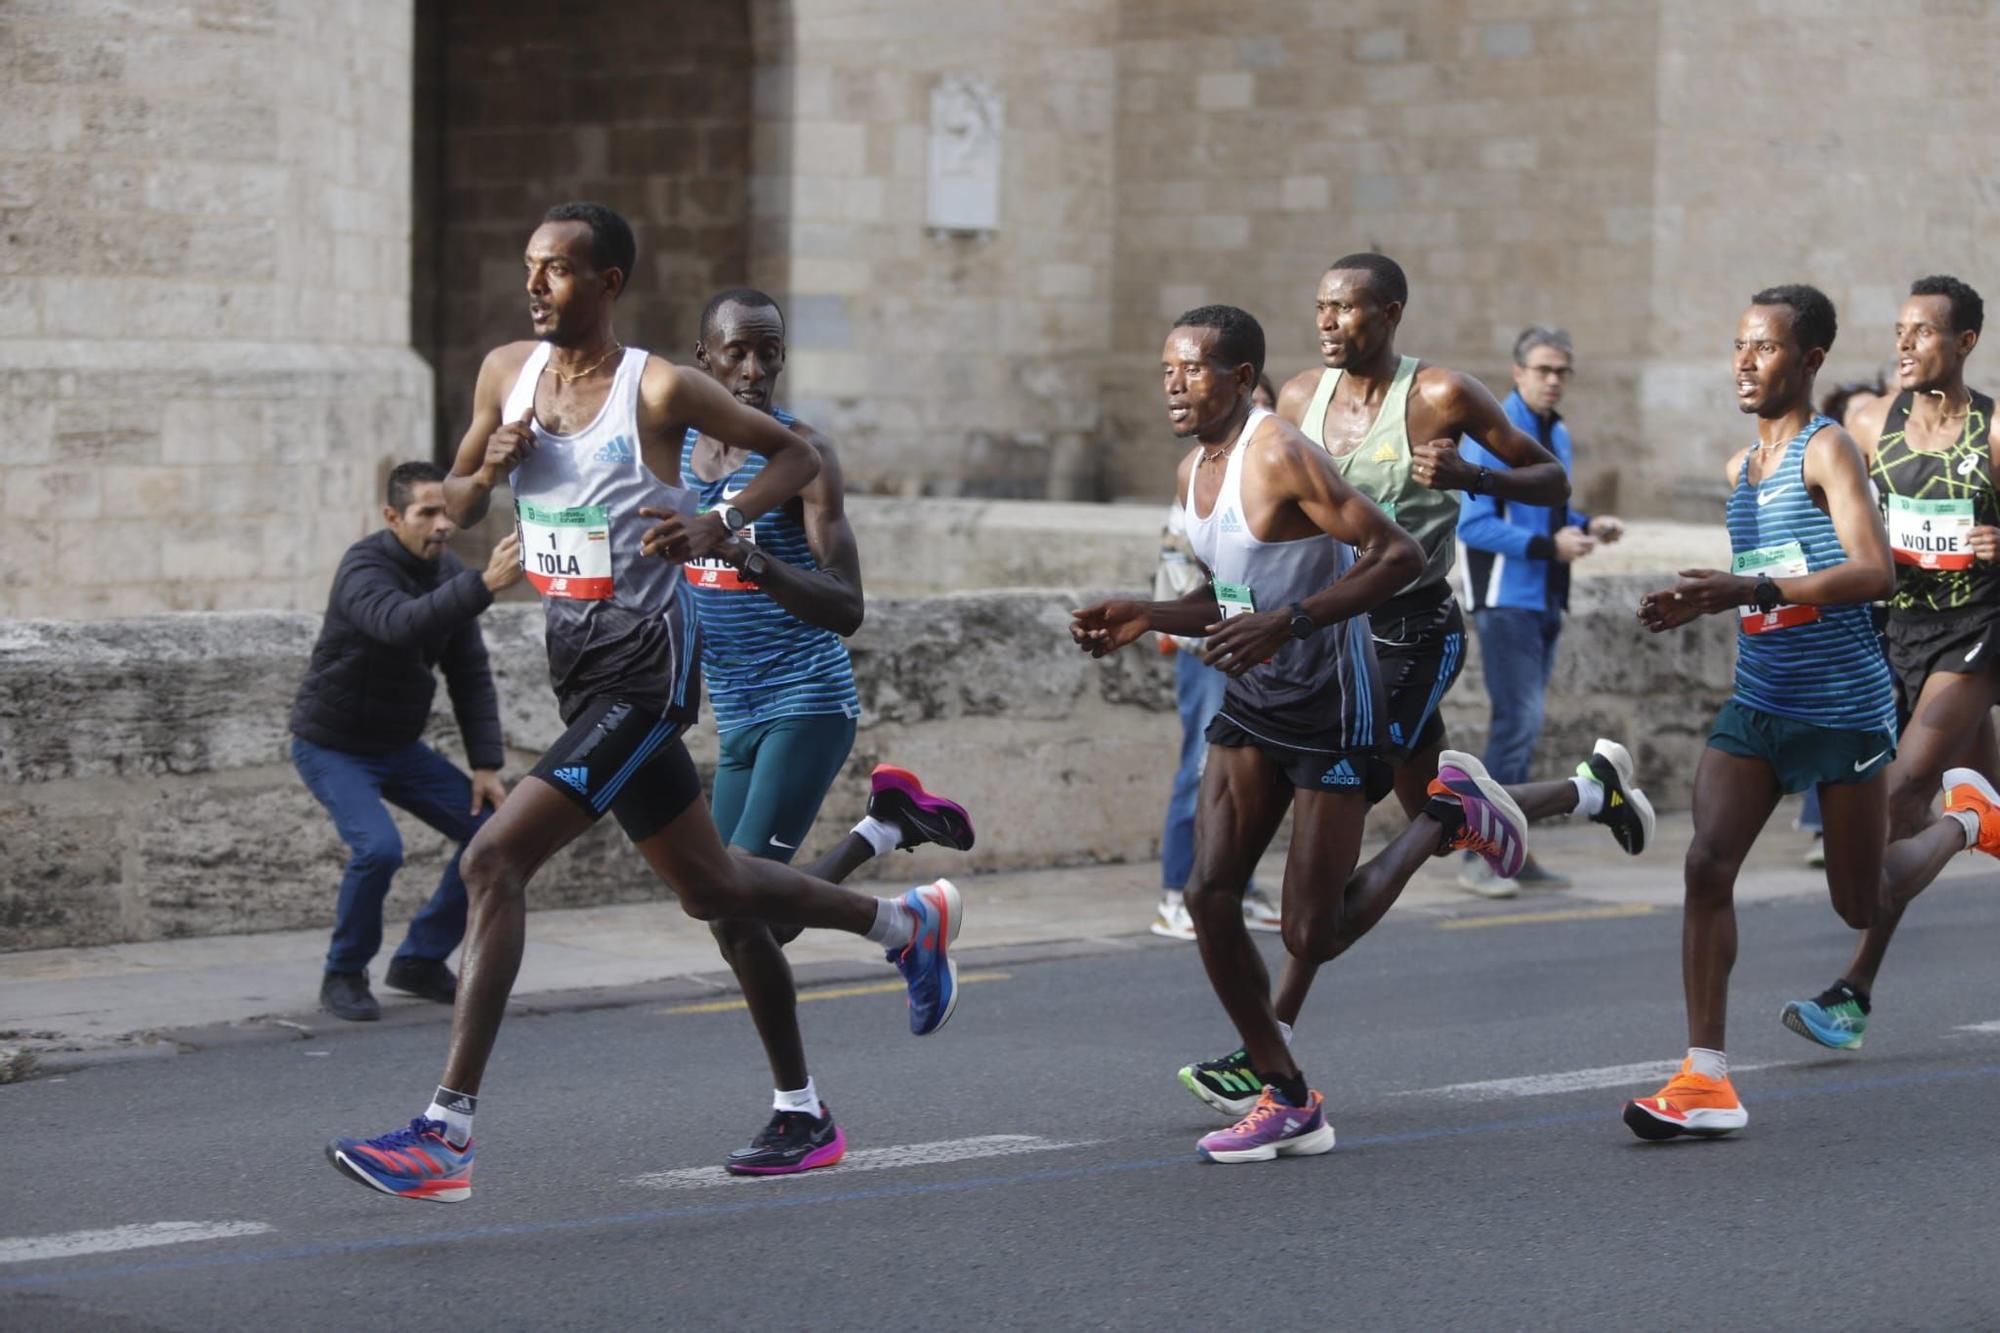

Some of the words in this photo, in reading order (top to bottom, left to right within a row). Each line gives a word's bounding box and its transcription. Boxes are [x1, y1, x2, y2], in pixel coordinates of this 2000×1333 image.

[1922, 520, 1931, 532] 4
[548, 532, 557, 550] 1
[1901, 532, 1958, 552] WOLDE
[536, 552, 581, 575] TOLA
[1321, 772, 1361, 785] adidas
